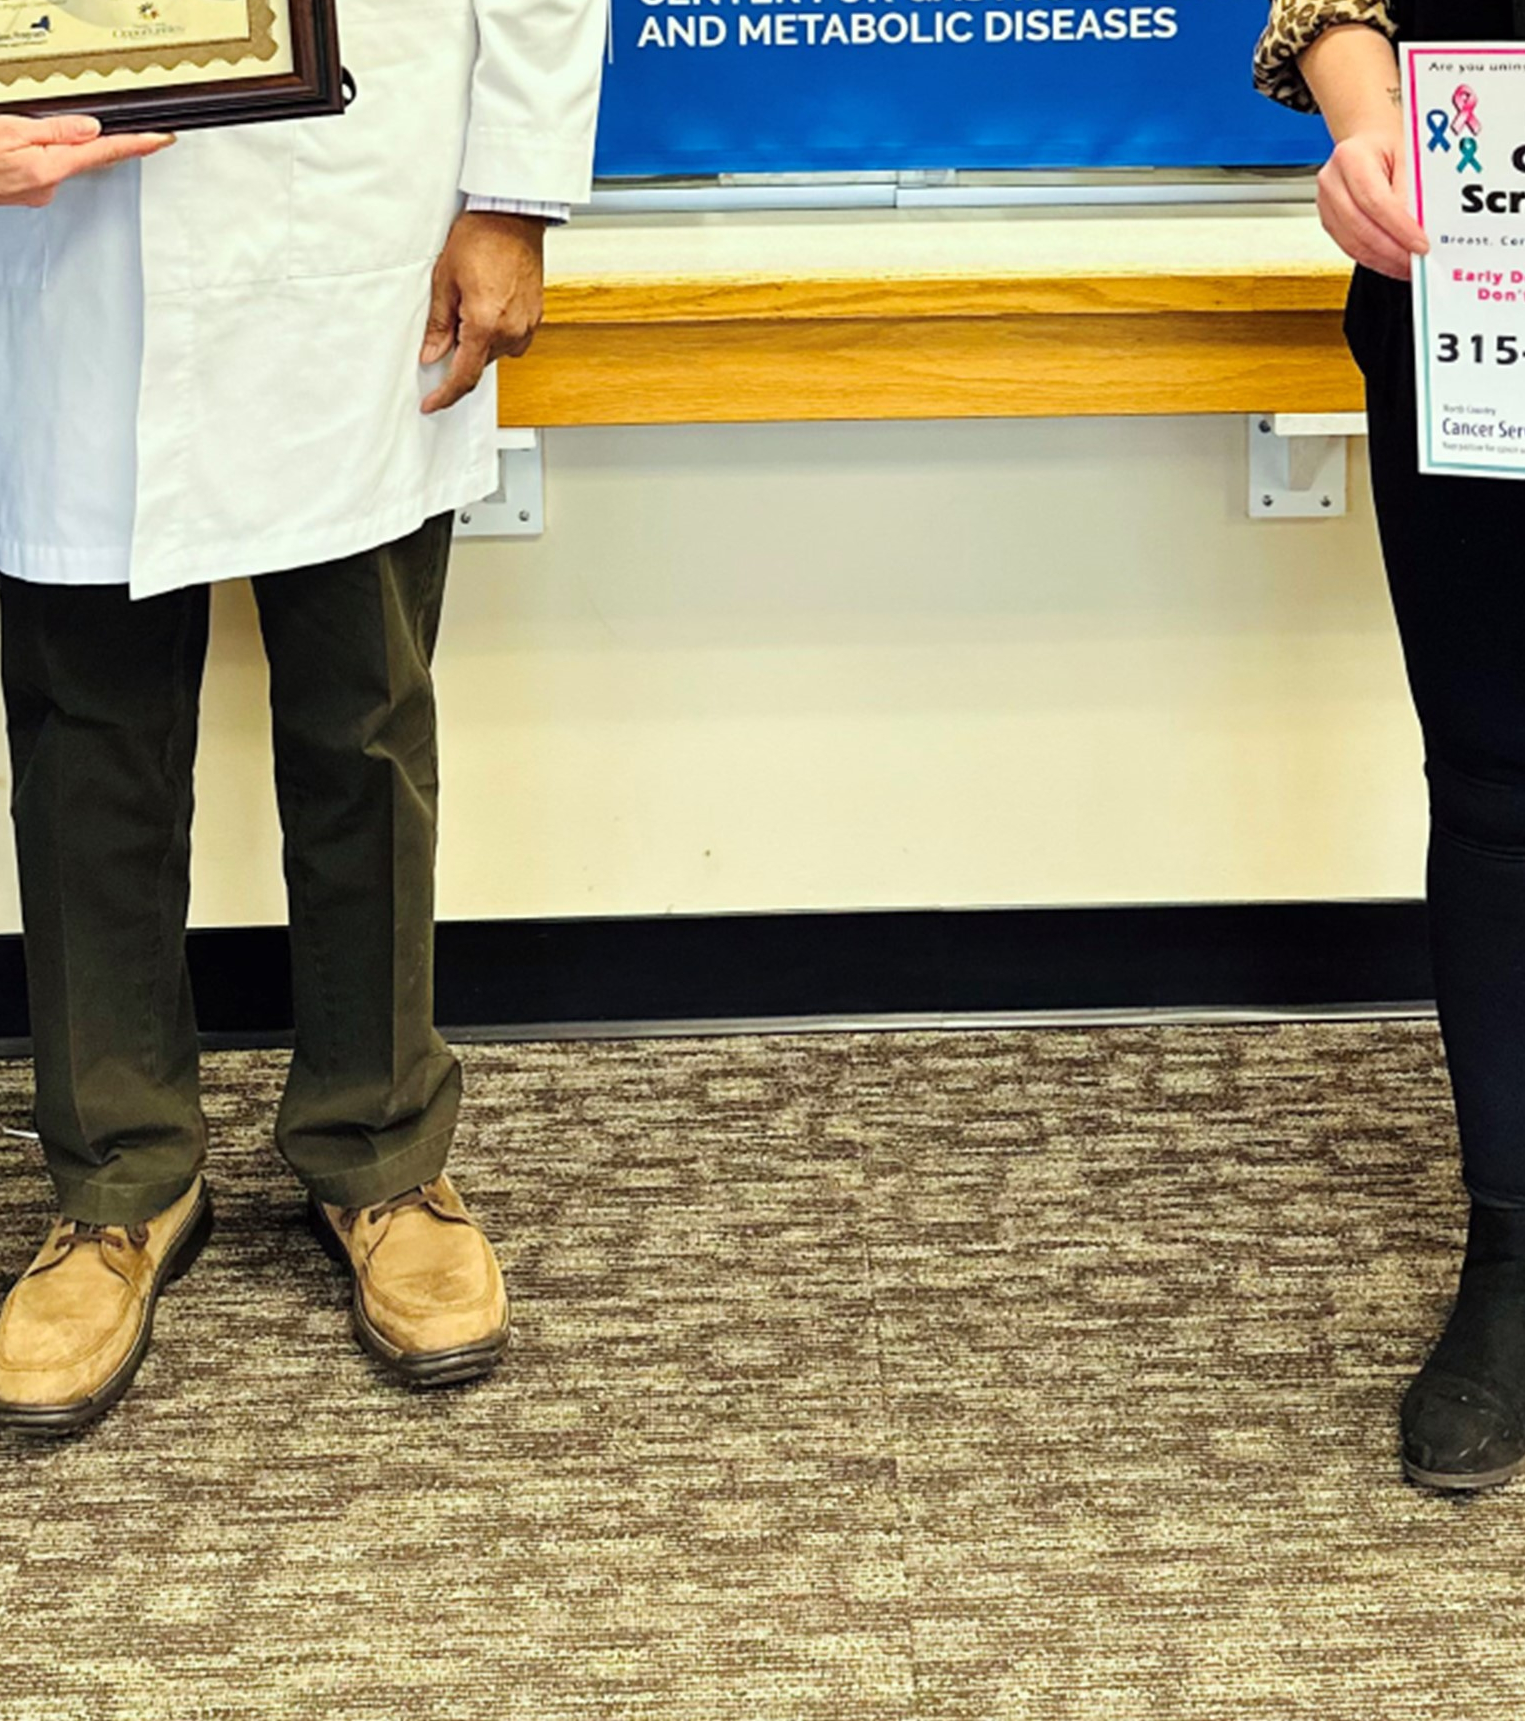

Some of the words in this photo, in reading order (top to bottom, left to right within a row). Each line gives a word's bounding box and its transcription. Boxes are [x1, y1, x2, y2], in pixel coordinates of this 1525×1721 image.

[636, 14, 727, 48] AND
[738, 10, 974, 47] METABOLIC
[983, 6, 1179, 43] DISEASES
[1428, 61, 1454, 72] Are
[1458, 62, 1485, 75] you
[1452, 268, 1504, 287] Early
[1441, 417, 1494, 438] Cancer
